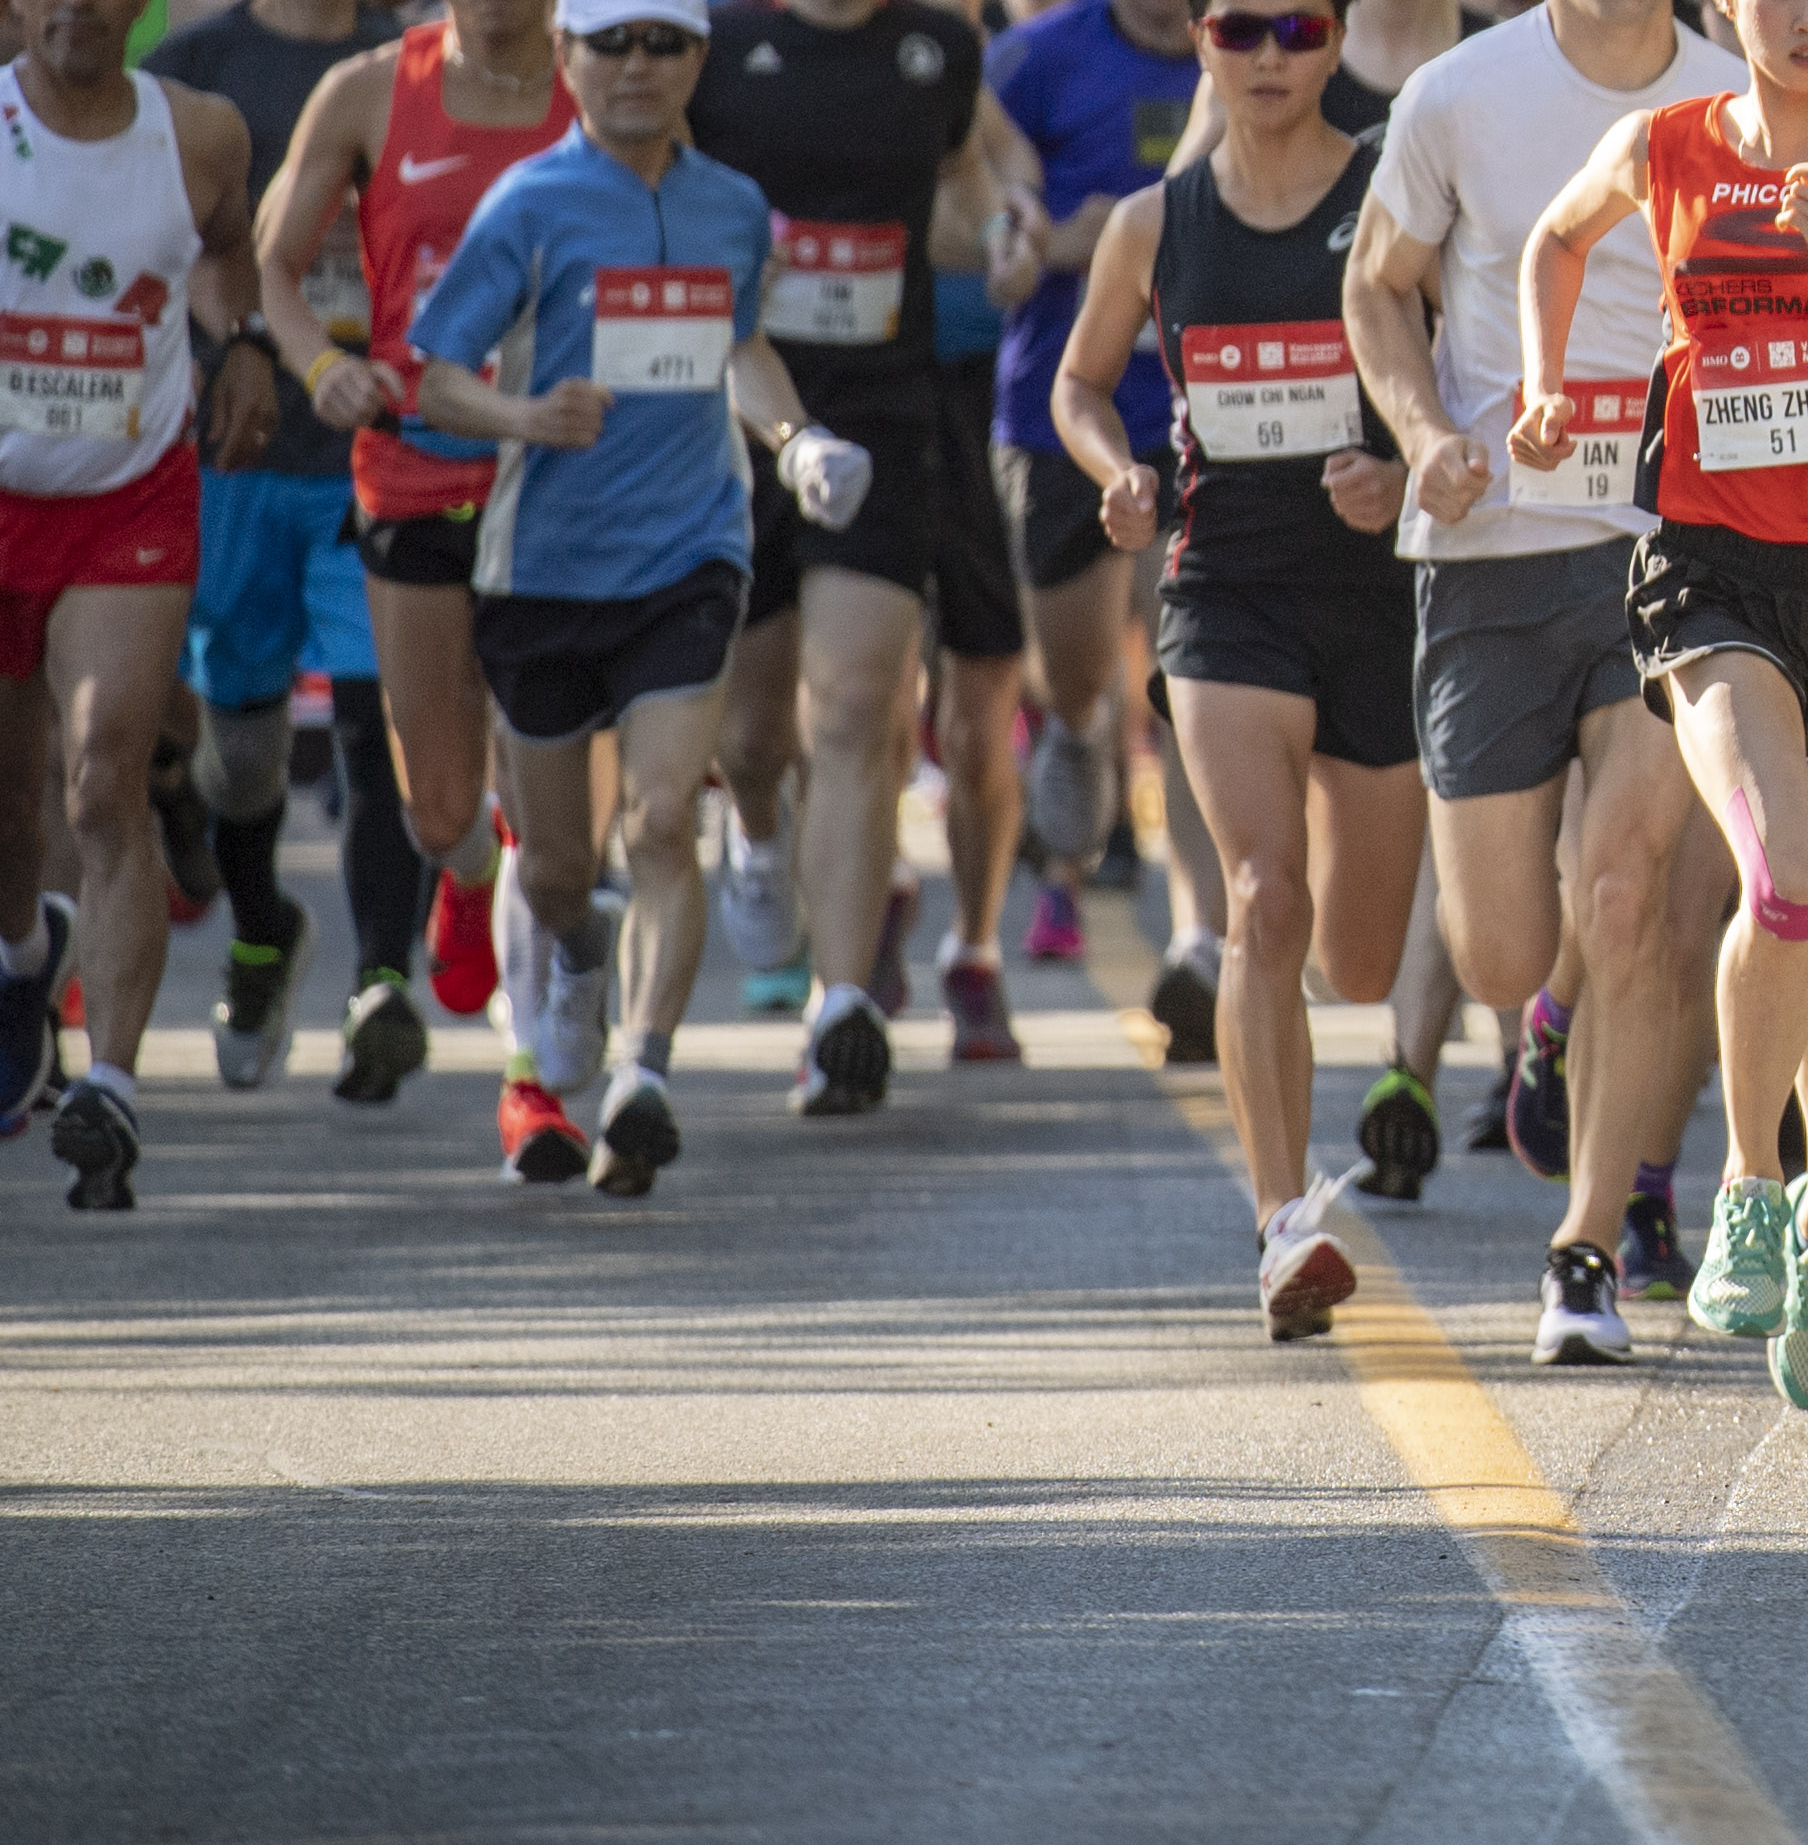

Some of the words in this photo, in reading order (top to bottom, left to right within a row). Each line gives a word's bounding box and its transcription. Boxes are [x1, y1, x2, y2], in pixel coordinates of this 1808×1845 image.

[1217, 388, 1255, 406] CHOW
[1261, 387, 1283, 404] CHI
[1288, 386, 1325, 402] NGAN
[1702, 392, 1773, 425] ZHENG
[1257, 420, 1283, 447] 59
[1770, 427, 1796, 455] 51
[1583, 440, 1619, 466] IAN
[1587, 473, 1609, 499] 19
